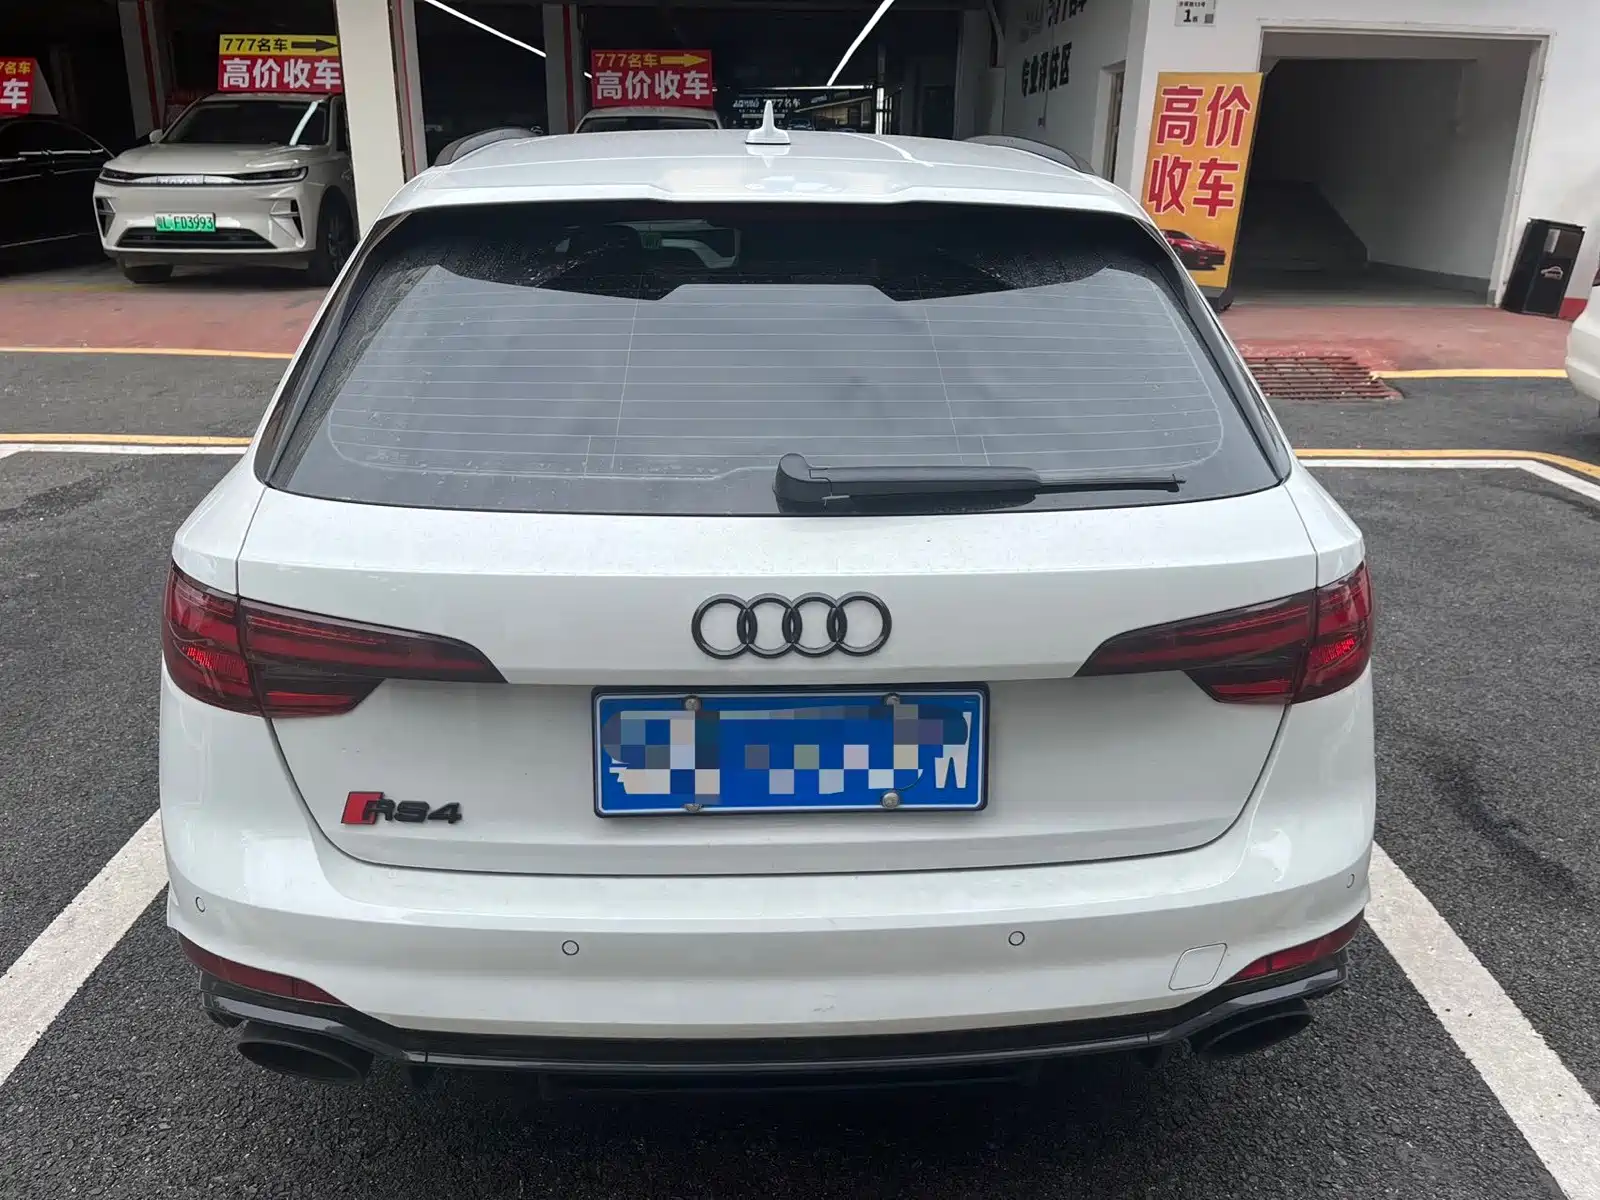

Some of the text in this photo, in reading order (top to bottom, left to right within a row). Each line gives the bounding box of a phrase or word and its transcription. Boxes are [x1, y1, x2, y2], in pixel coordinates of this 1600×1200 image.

[223, 38, 288, 52] 777名车
[223, 58, 341, 89] 高价收车
[595, 53, 658, 68] 777名车
[596, 70, 710, 100] 高价收车
[1156, 84, 1251, 147] 高价
[1147, 153, 1239, 217] 收车
[361, 797, 462, 824] RS4
